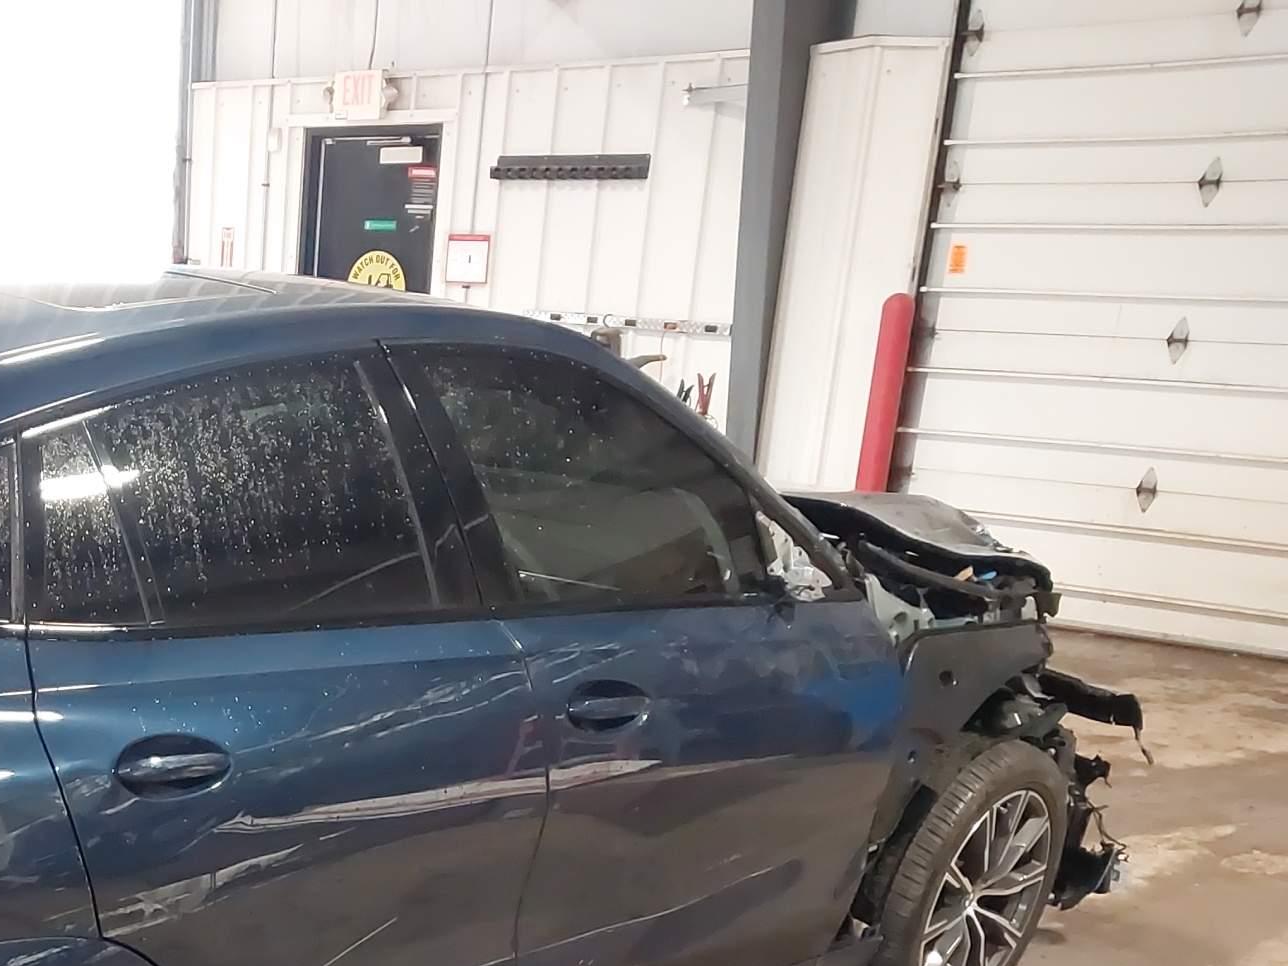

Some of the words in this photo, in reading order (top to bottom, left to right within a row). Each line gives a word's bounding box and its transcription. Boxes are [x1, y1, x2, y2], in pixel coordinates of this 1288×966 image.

[343, 74, 375, 105] EXIT
[352, 255, 374, 280] WATCH
[375, 254, 389, 265] OUT
[388, 262, 401, 281] FOR
